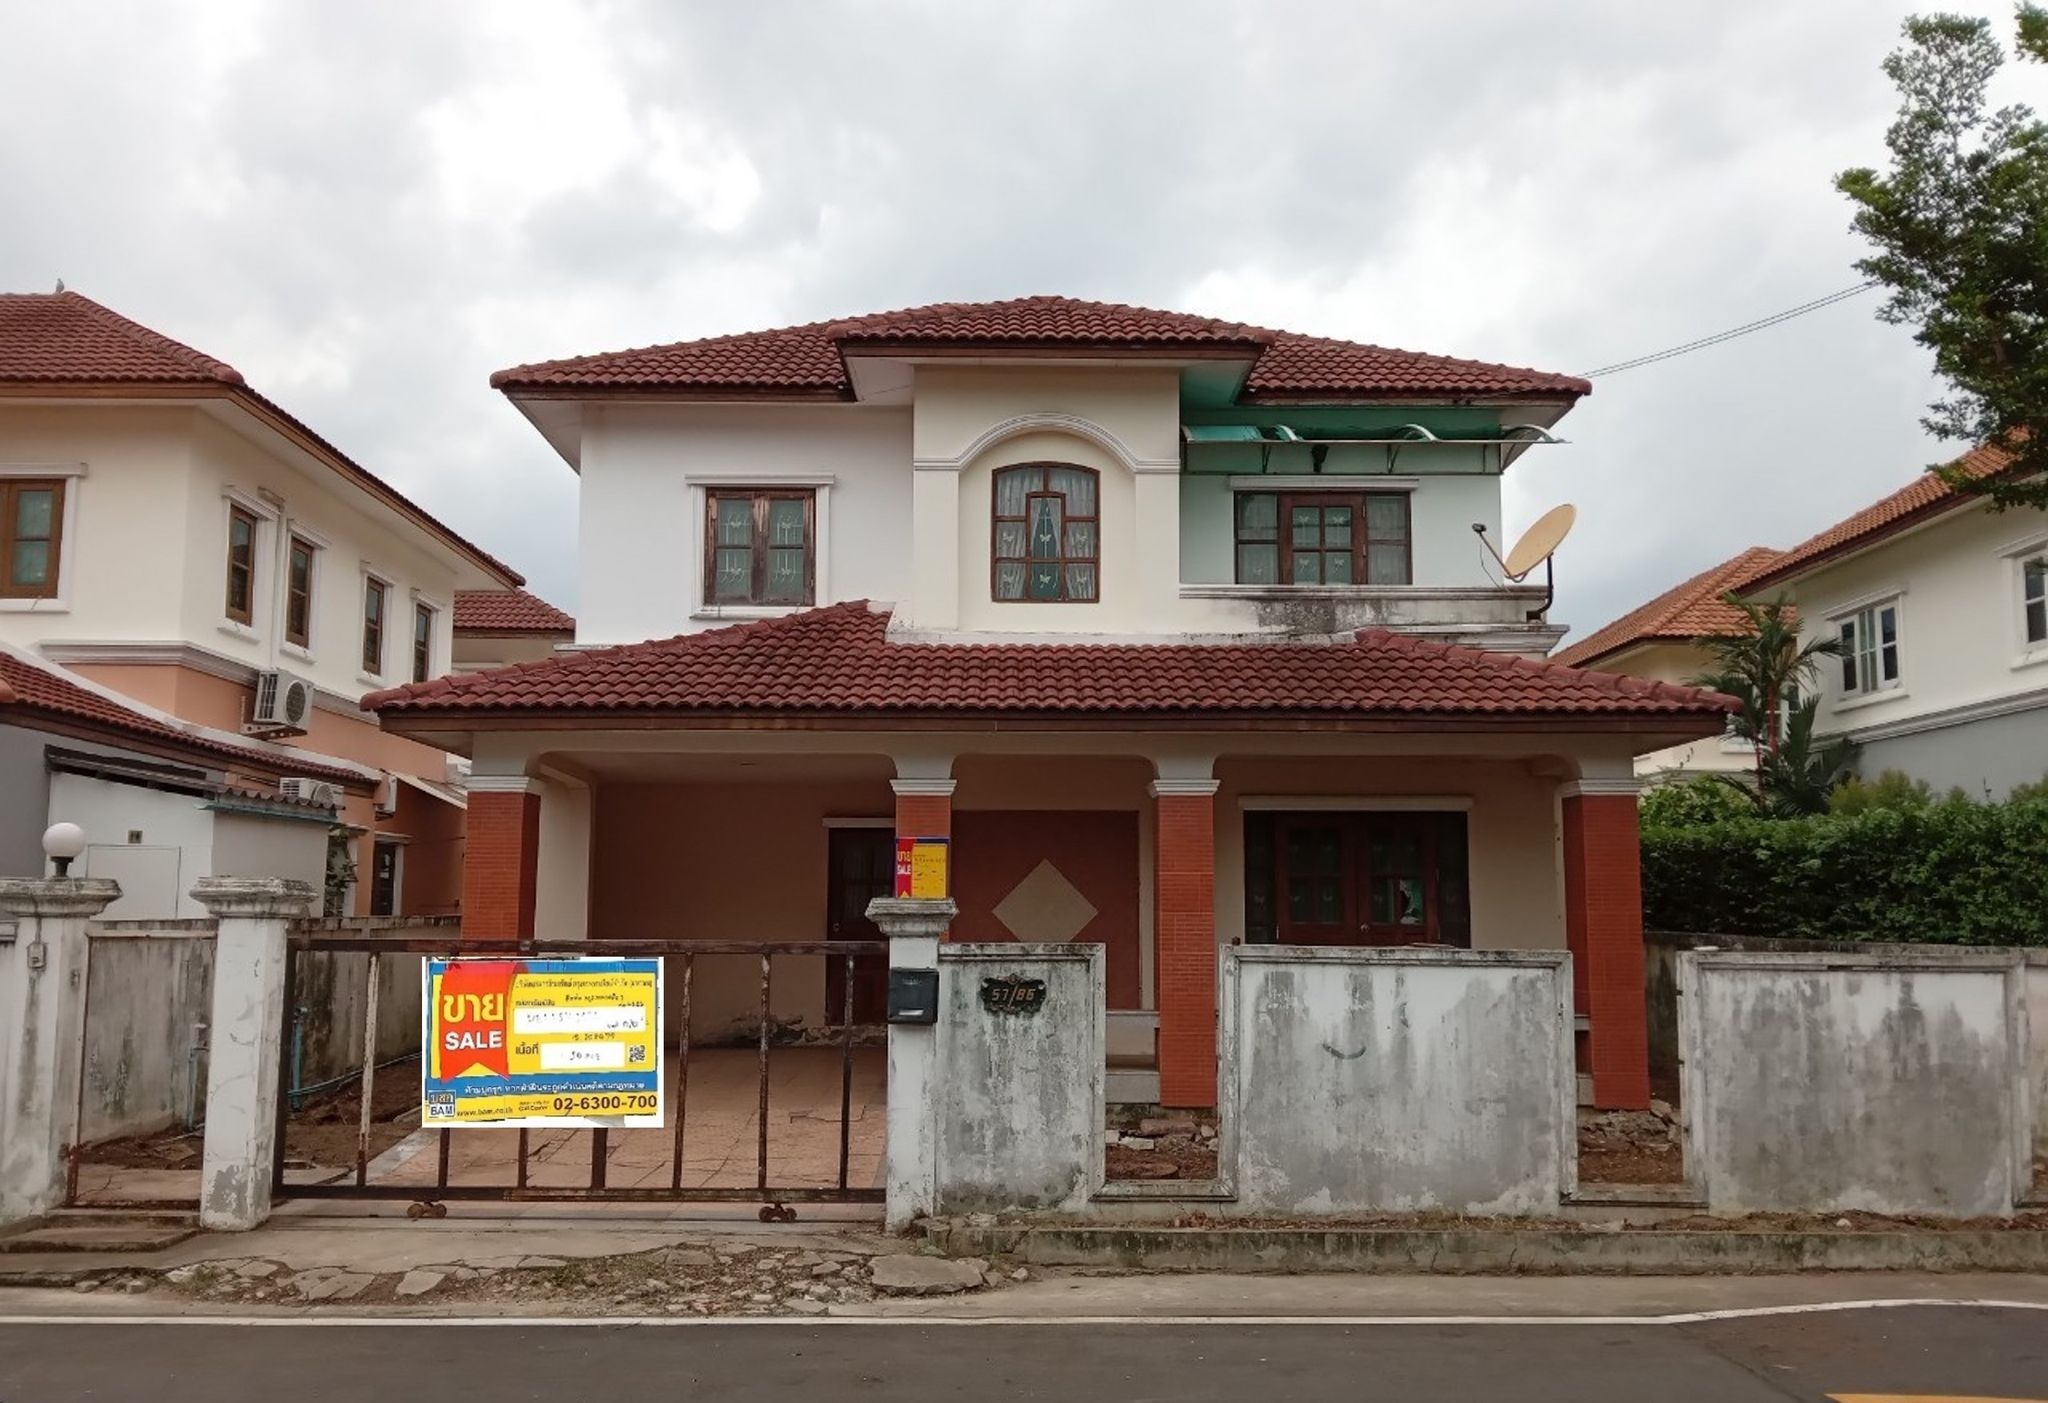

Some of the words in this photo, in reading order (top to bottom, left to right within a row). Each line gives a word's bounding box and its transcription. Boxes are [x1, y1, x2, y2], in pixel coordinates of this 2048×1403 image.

[443, 992, 504, 1023] ขาย
[445, 1030, 503, 1051] SALE
[430, 1105, 453, 1116] BAM
[553, 1095, 657, 1111] 02-6300-700
